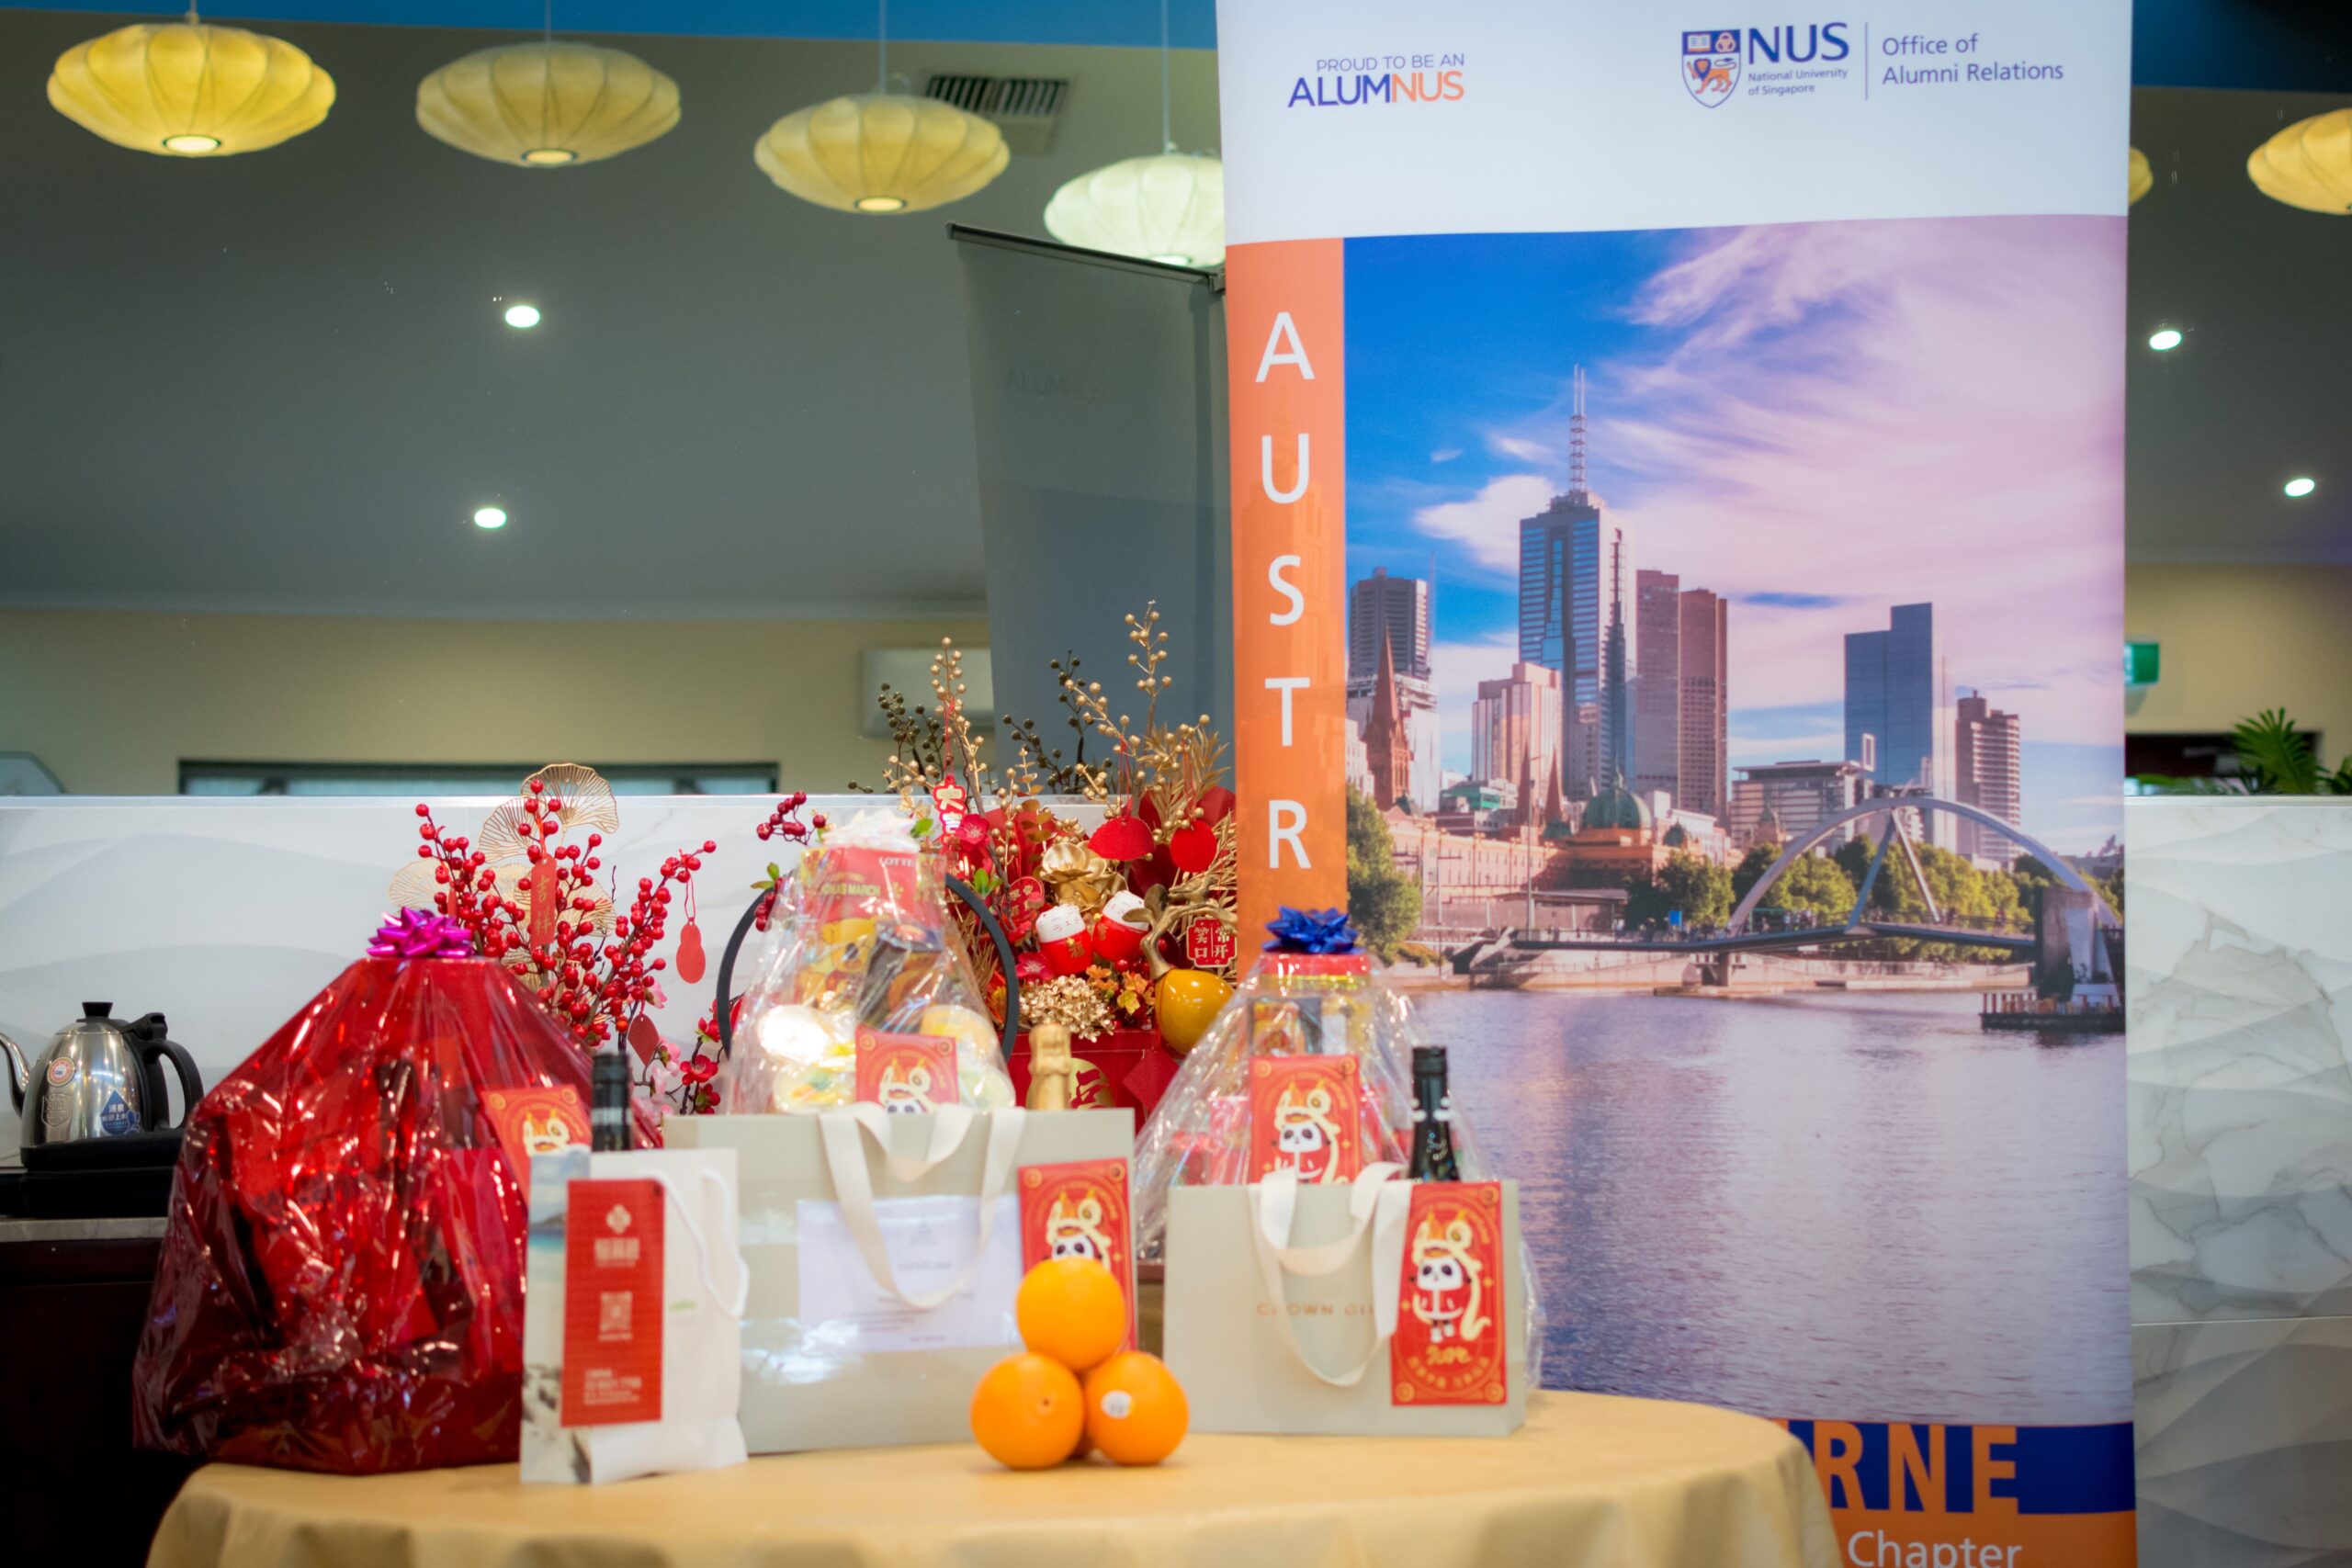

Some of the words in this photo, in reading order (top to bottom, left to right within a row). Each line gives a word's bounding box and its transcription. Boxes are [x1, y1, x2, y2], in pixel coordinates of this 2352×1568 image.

[1747, 22, 1849, 65] NUS
[1882, 35, 1949, 56] Office
[1955, 32, 1979, 54] of
[1316, 57, 1378, 73] PROUD
[1383, 55, 1407, 70] TO
[1411, 54, 1435, 69] BE
[1440, 52, 1465, 68] AN
[1882, 63, 1959, 85] Alumni
[1966, 61, 2064, 82] Relations
[1747, 70, 1792, 83] National
[1795, 68, 1849, 80] University
[1287, 70, 1465, 108] ALUMNUS
[1747, 85, 1759, 96] of
[1761, 84, 1815, 97] Singapore
[1256, 1303, 1333, 1316] COWN
[1771, 1419, 2019, 1514] RNE
[1847, 1529, 2023, 1568] Chapter
